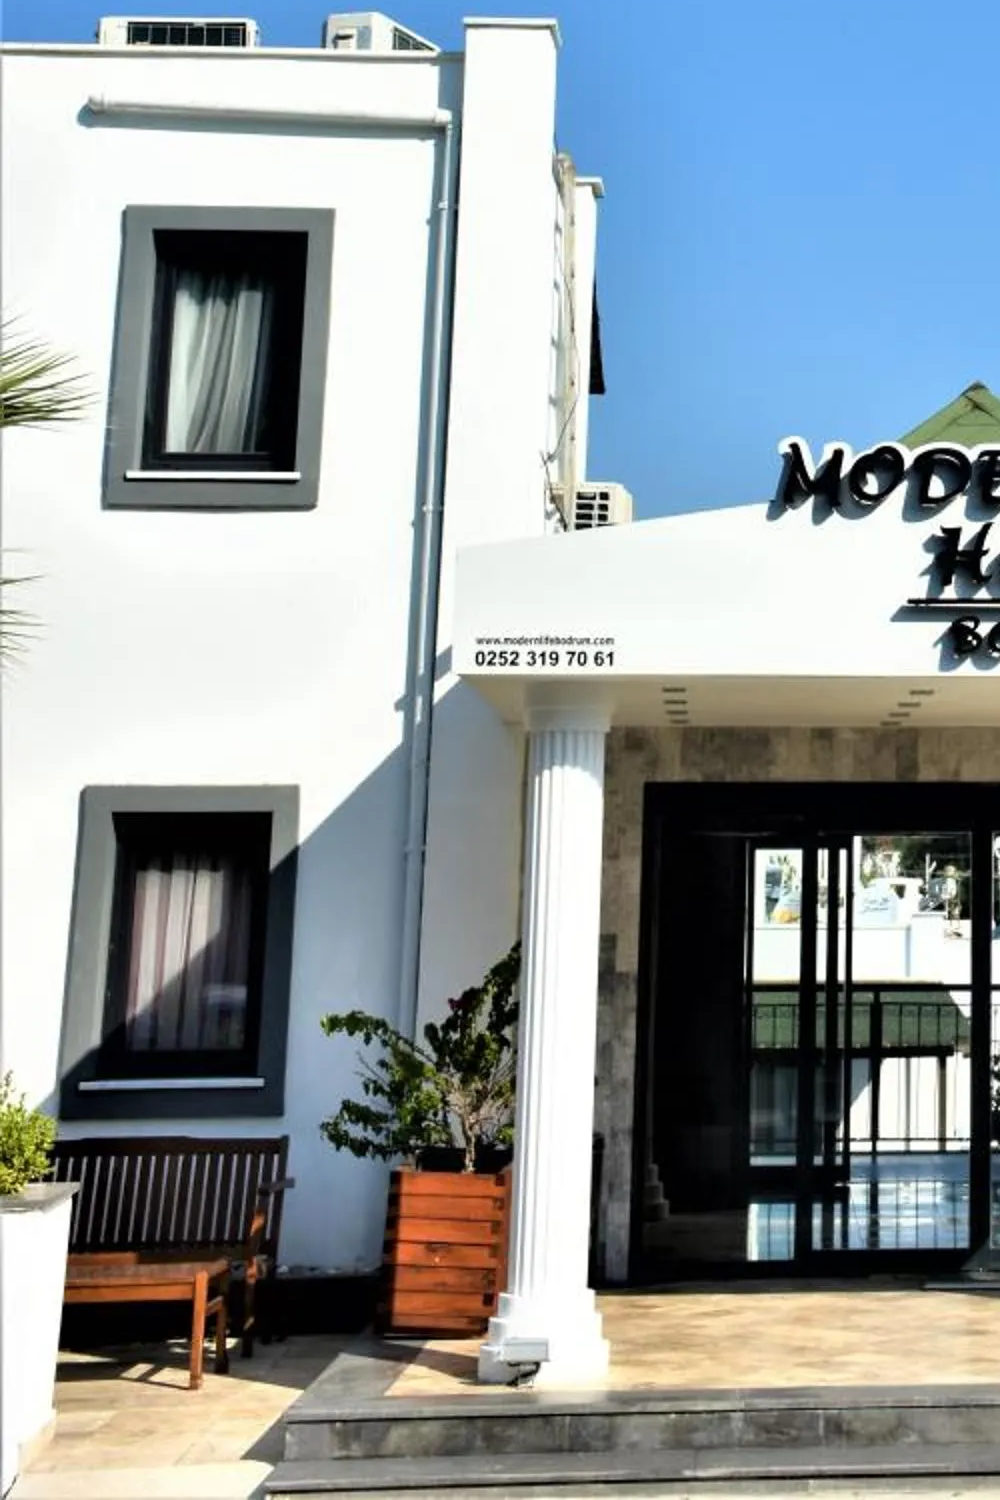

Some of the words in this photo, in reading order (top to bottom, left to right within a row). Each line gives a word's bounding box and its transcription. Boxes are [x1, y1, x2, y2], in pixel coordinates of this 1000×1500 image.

[475, 635, 615, 646] www.modernlifebodrum.com
[475, 650, 519, 667] 0252
[526, 650, 559, 667] 319
[566, 650, 588, 667] 70
[593, 650, 615, 667] 61
